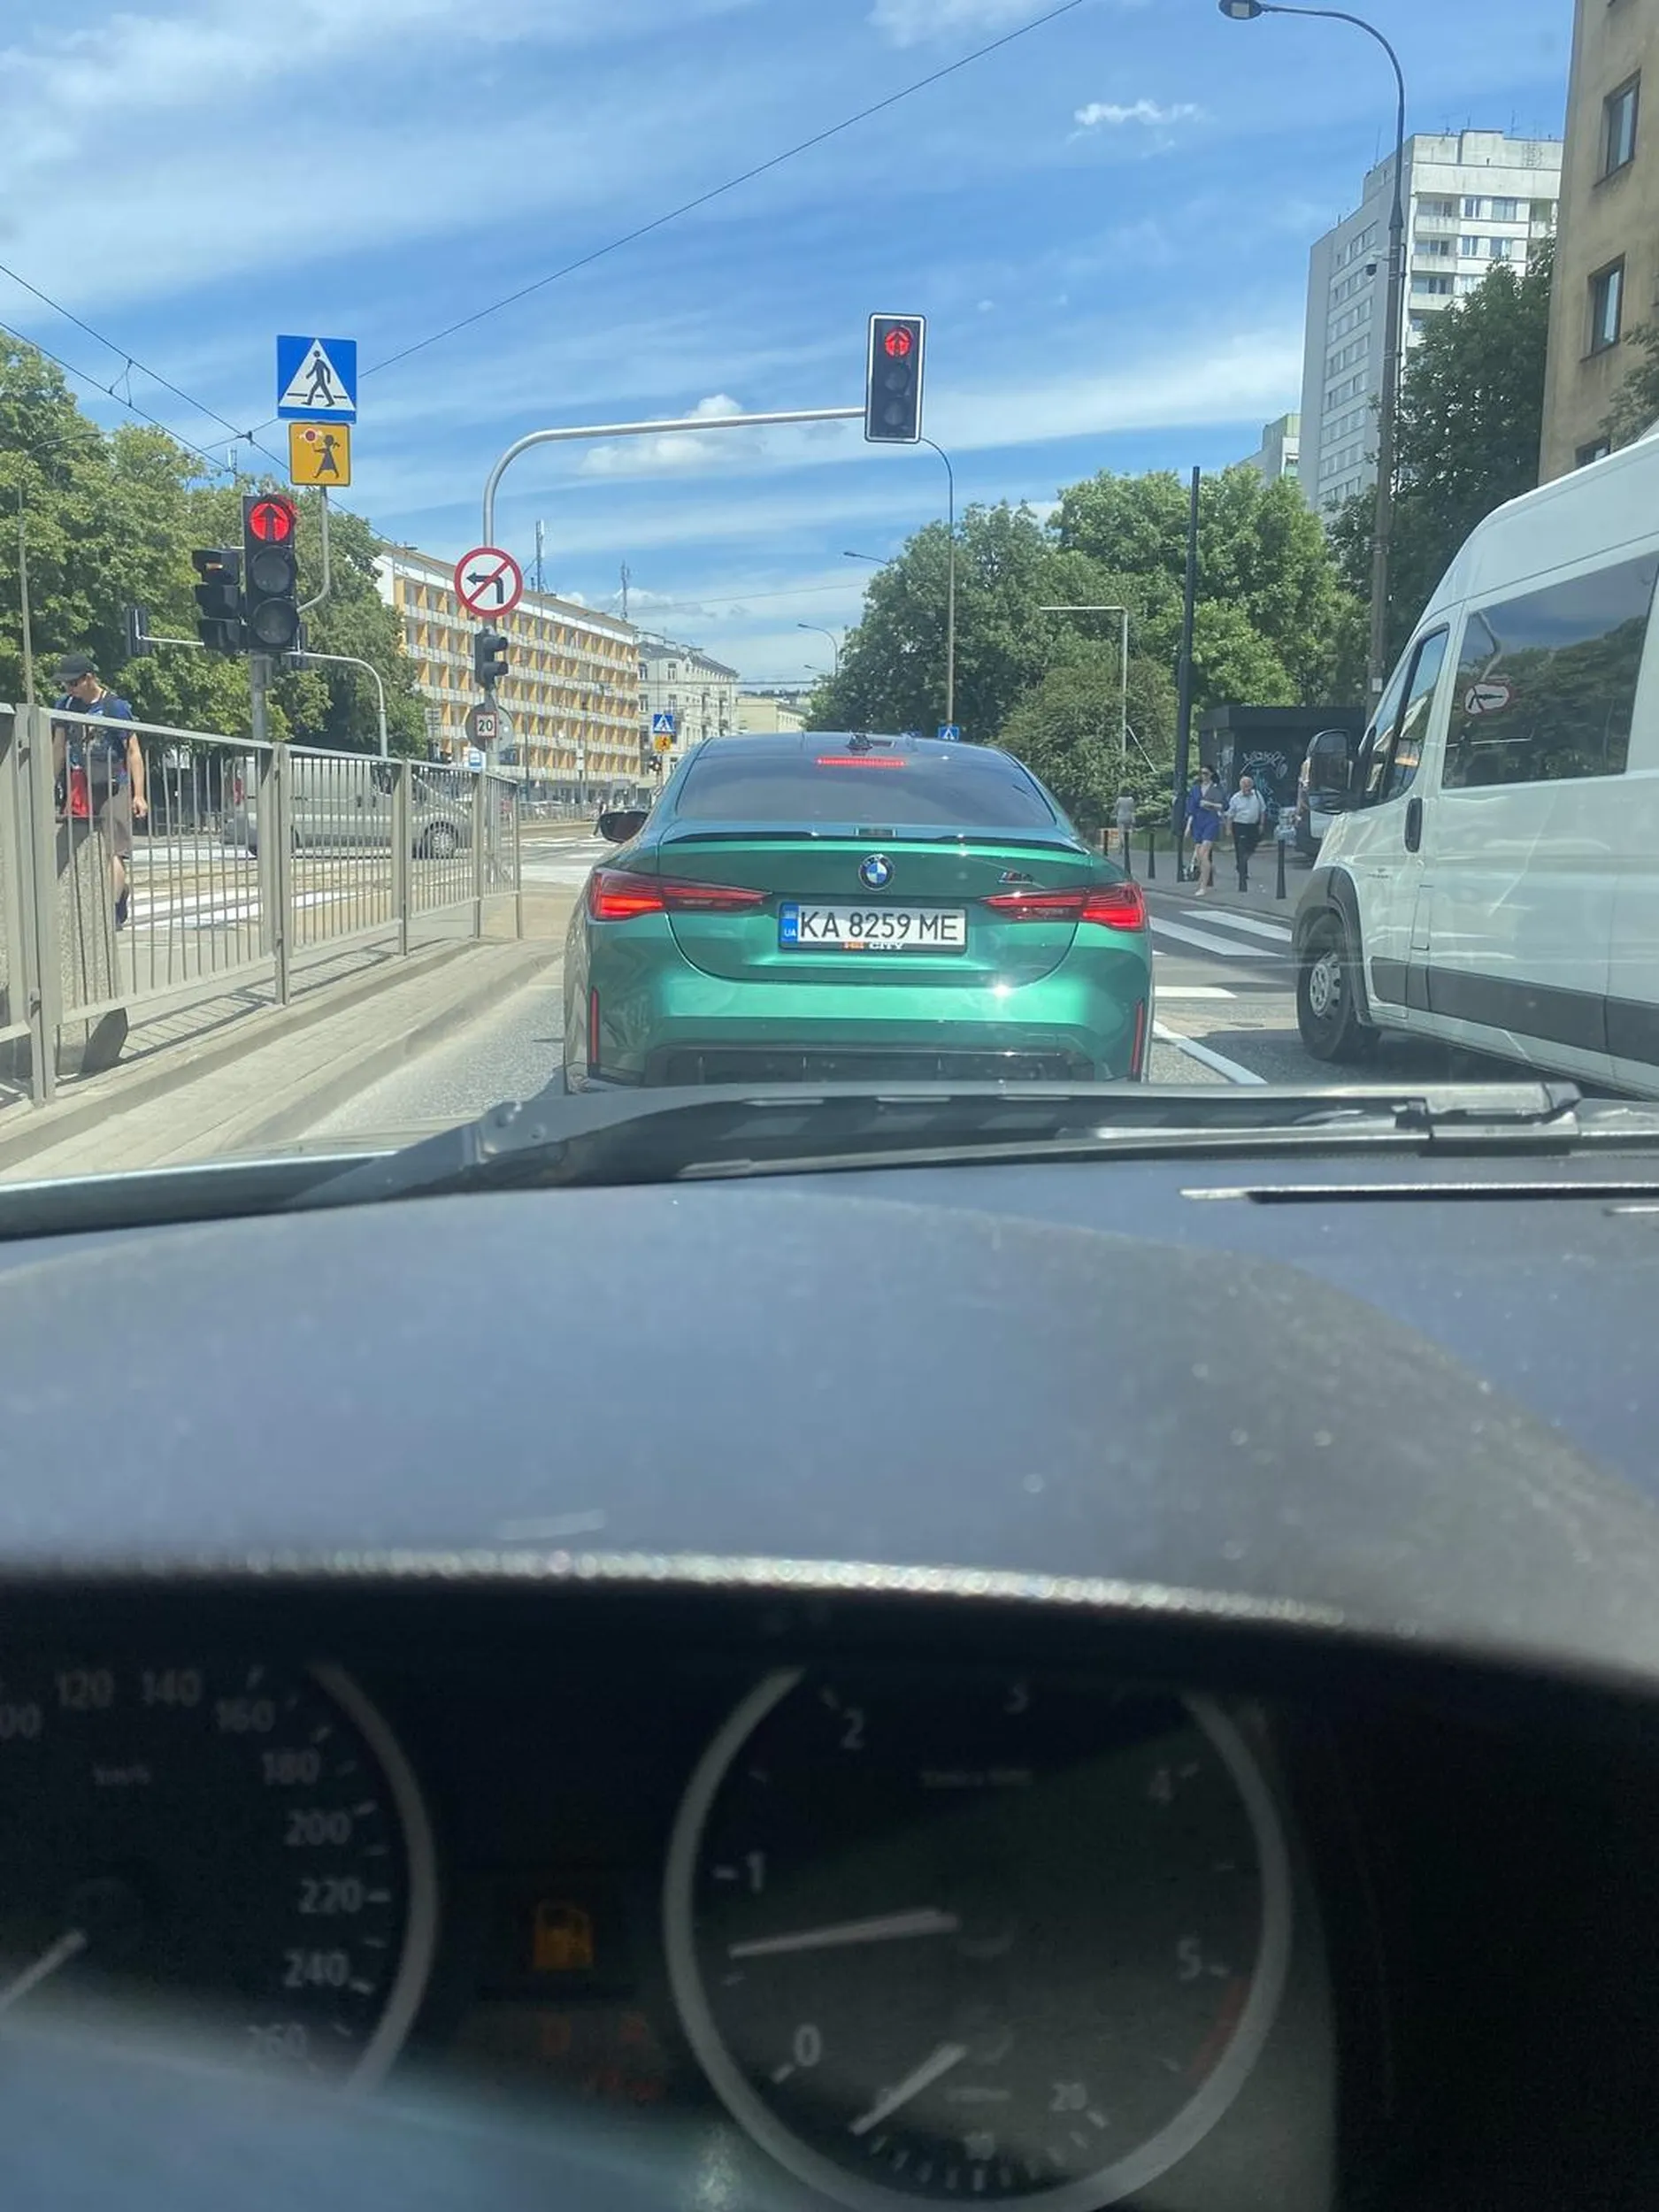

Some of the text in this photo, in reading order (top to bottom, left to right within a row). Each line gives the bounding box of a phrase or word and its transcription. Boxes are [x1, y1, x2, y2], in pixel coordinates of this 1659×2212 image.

[479, 719, 494, 733] 20
[784, 928, 796, 937] UA
[800, 911, 957, 940] KA 8259 ME
[869, 941, 904, 950] CITY
[58, 1669, 113, 1709] 120
[142, 1668, 202, 1706] 140
[0, 1702, 42, 1739] 00
[215, 1699, 274, 1732] 160
[840, 1707, 865, 1750] 2
[261, 1750, 320, 1786] 180
[284, 1809, 350, 1847] 200
[745, 1850, 767, 1895] 1
[298, 1878, 363, 1914] 220
[282, 1951, 349, 1988] 240
[1176, 1938, 1202, 1981] 5
[794, 2024, 821, 2067] 0
[1049, 2082, 1088, 2112] 20
